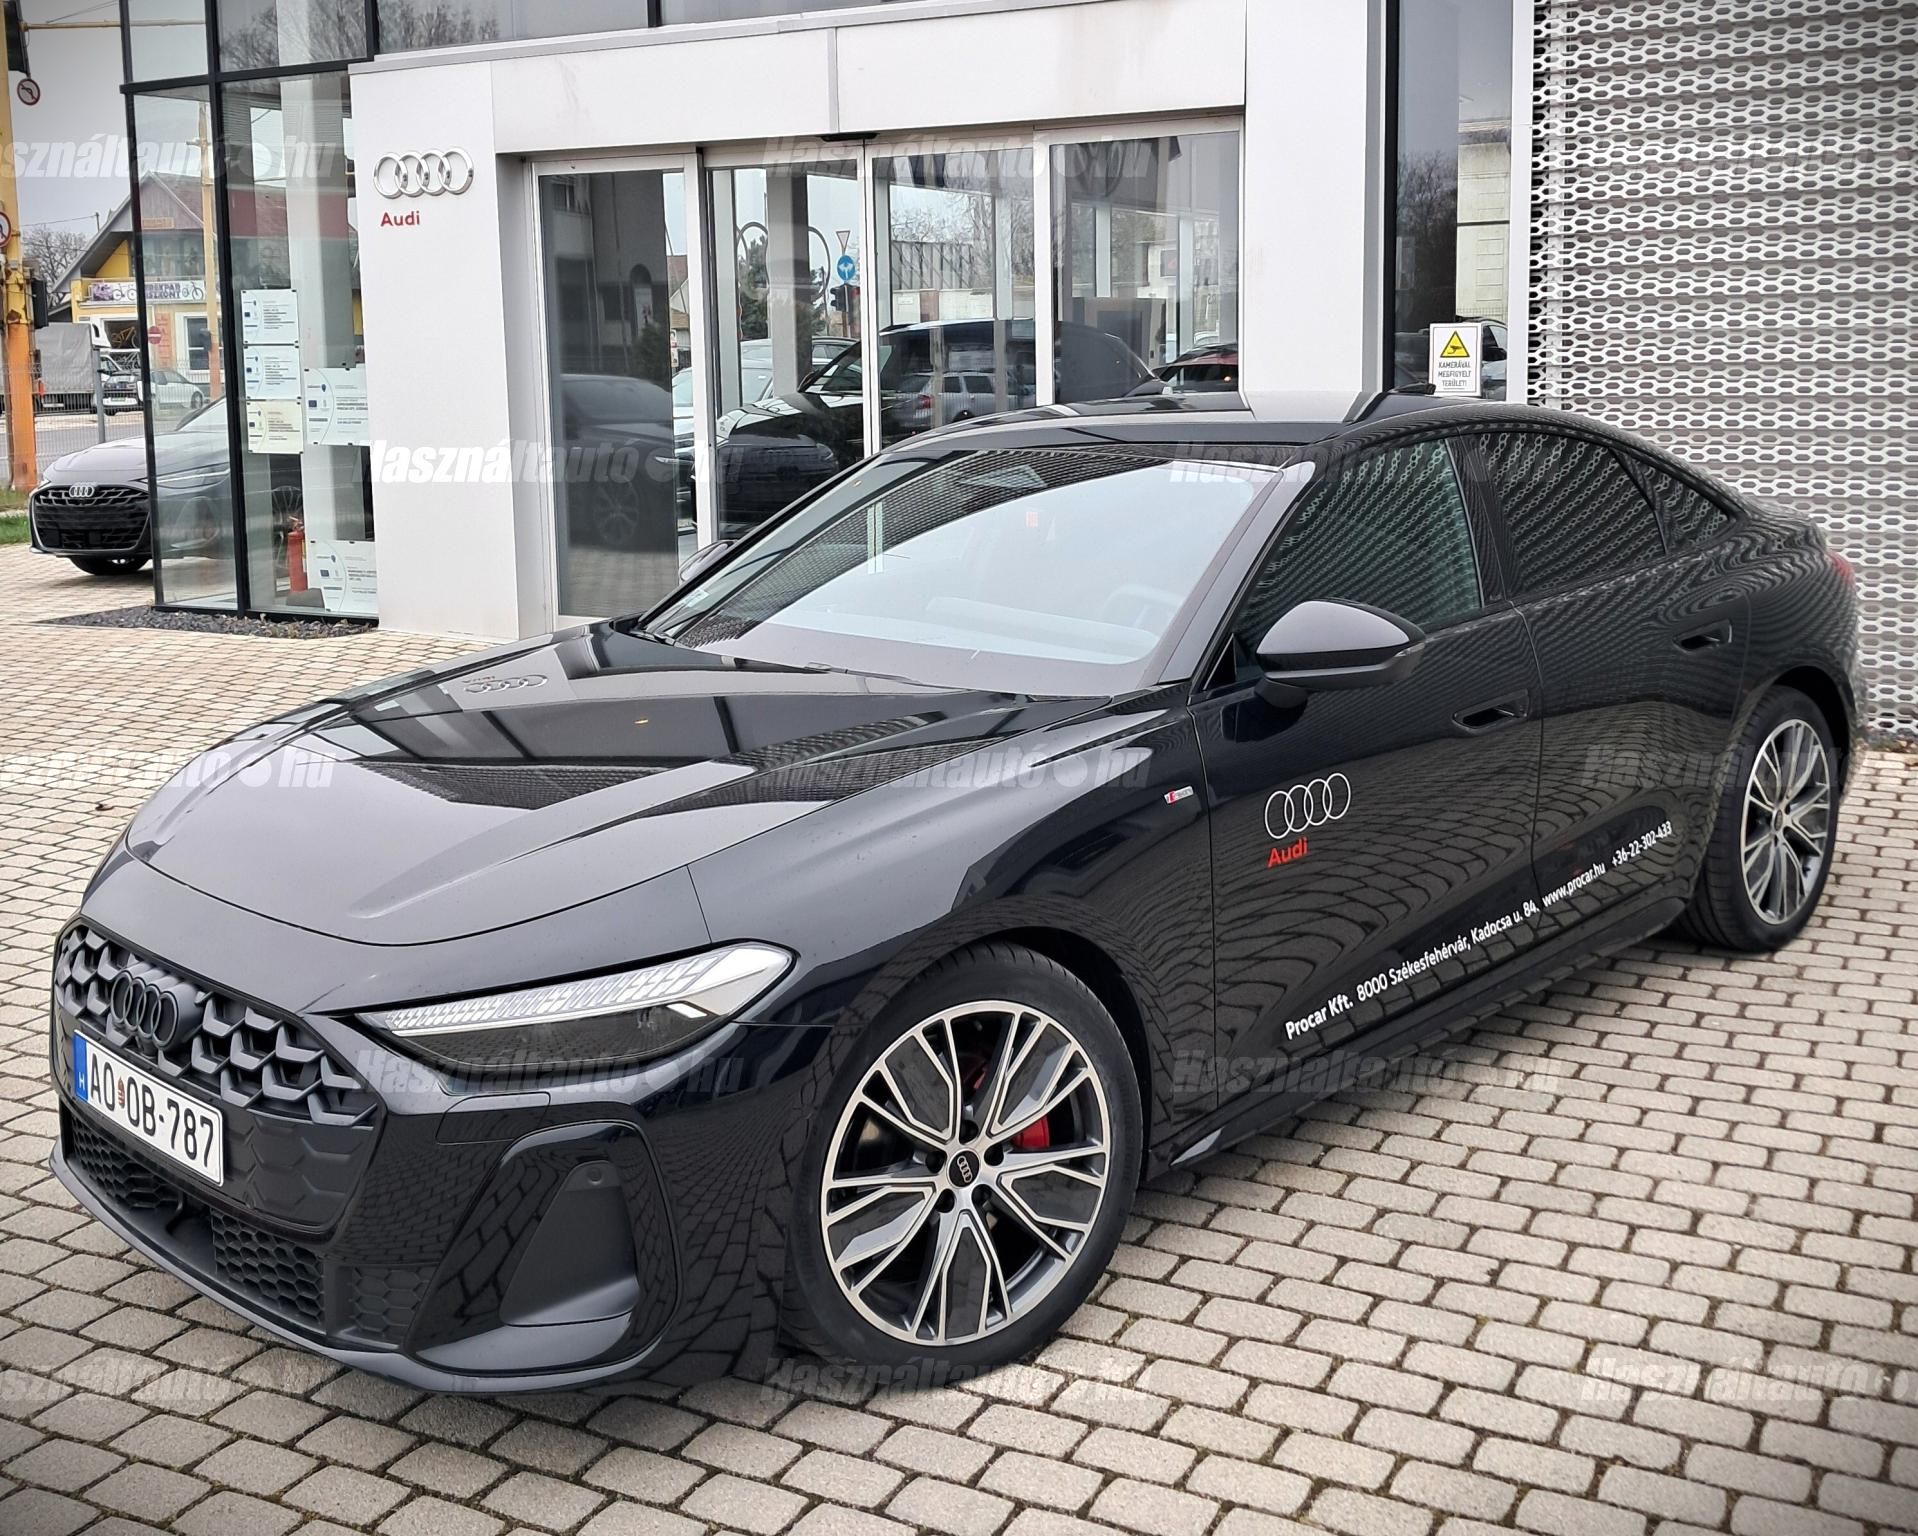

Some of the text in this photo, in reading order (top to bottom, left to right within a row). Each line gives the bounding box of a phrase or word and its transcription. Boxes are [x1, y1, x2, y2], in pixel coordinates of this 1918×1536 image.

[381, 210, 420, 227] Audi
[1438, 360, 1471, 369] KAMERÁVAL
[1438, 370, 1472, 378] MEGFIGYELT
[1267, 836, 1308, 868] Audi
[1285, 820, 1673, 1040] Procar Kft. 8000 Székesfehérvár, Kadocsa u. 84. www.procar.hu +36-22-302-433
[78, 1072, 86, 1091] H
[90, 1052, 214, 1168] AO OB-787
